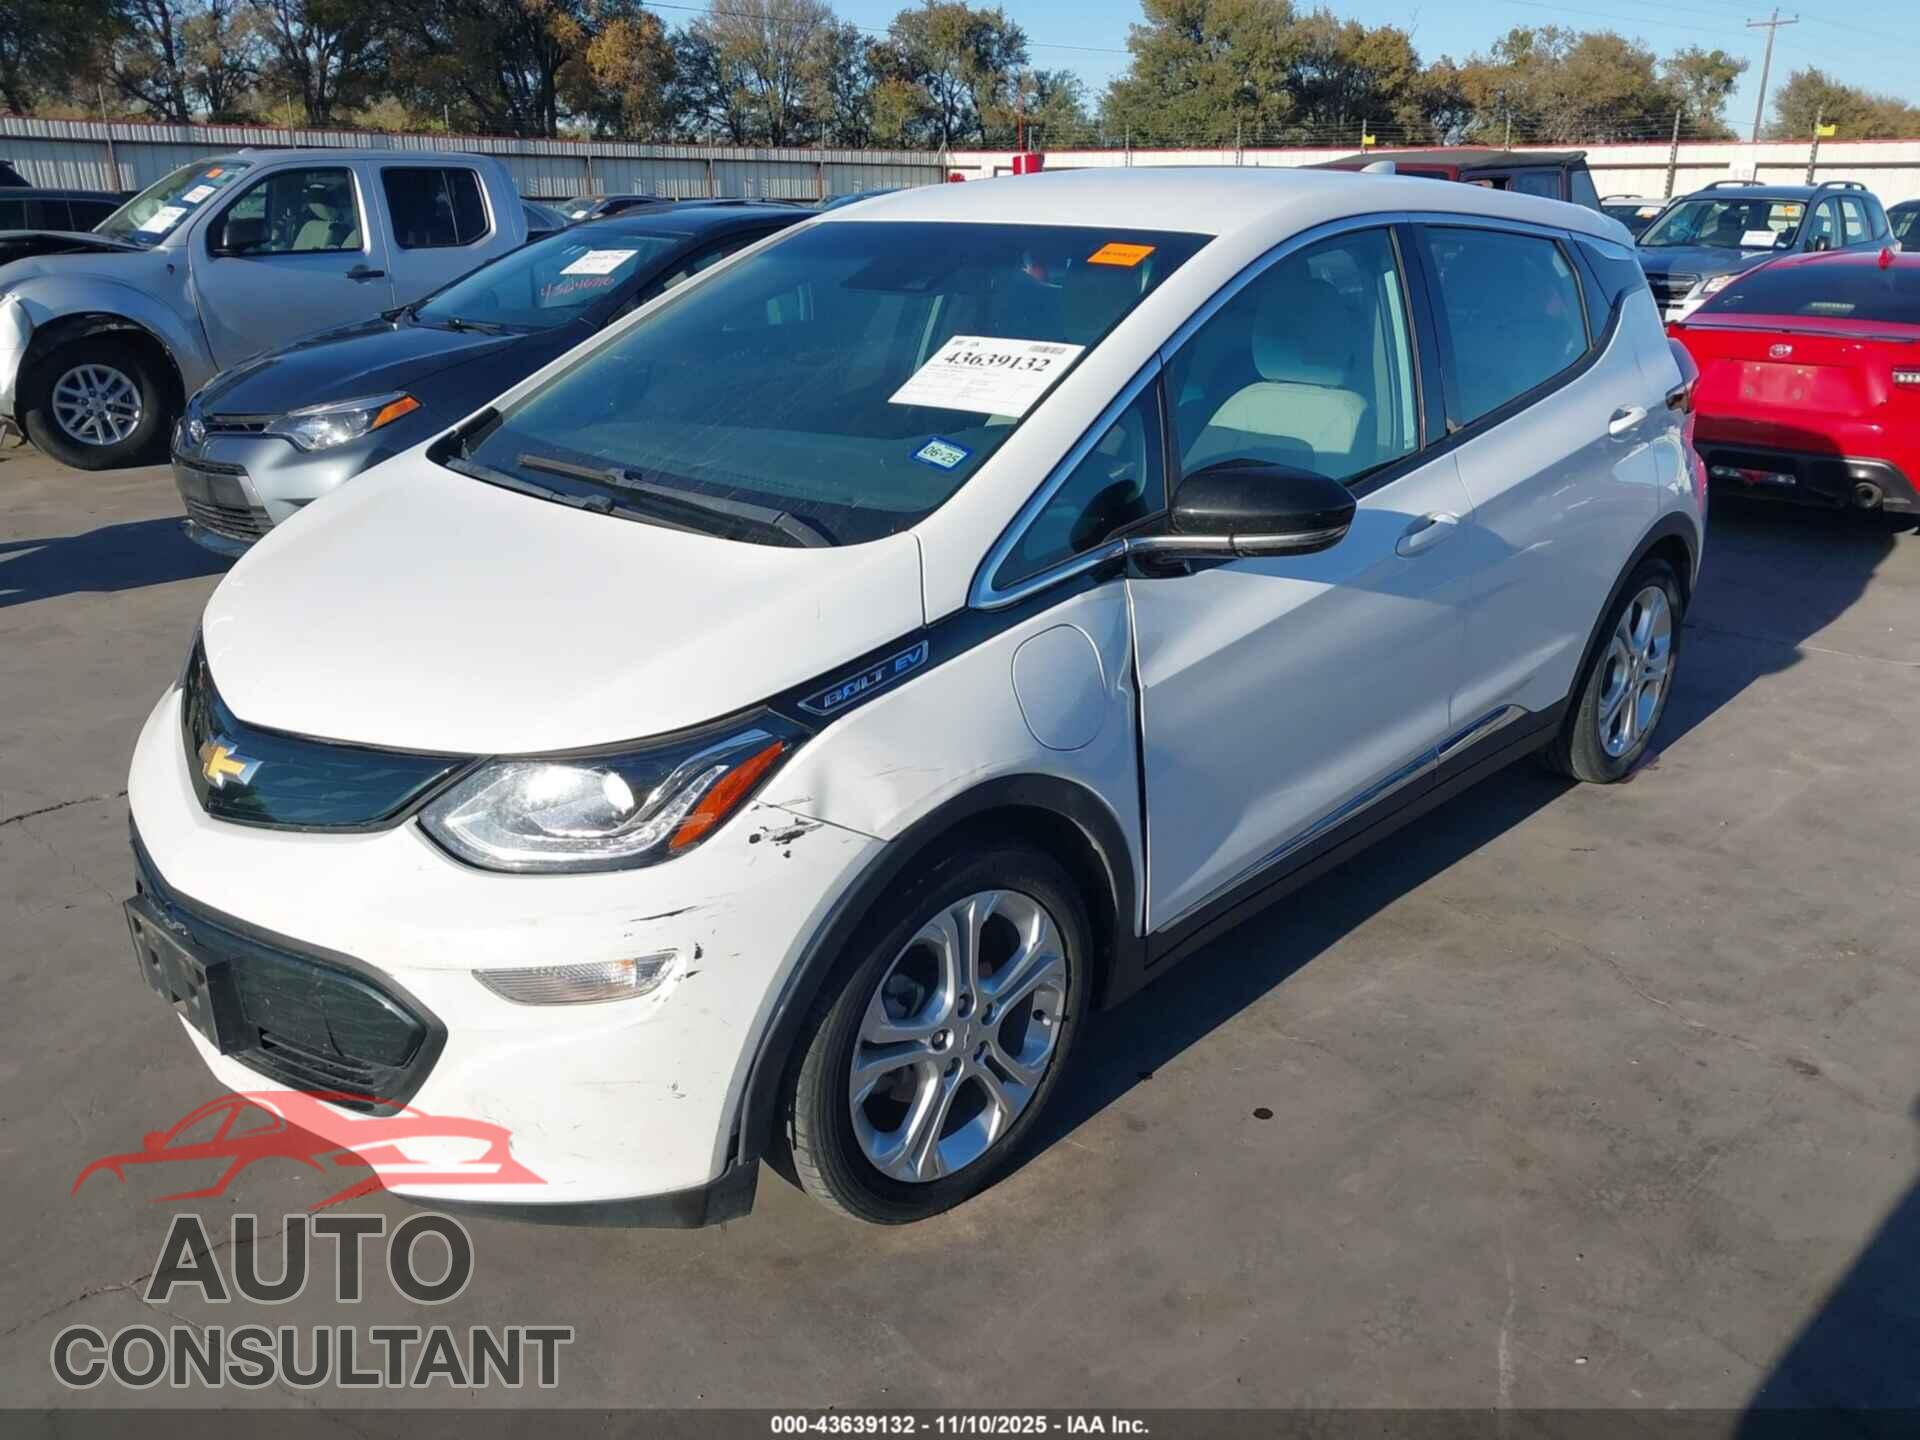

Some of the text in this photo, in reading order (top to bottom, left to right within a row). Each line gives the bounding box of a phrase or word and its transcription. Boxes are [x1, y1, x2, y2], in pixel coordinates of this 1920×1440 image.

[945, 350, 1051, 372] 43639132
[824, 649, 922, 708] BOLT EV
